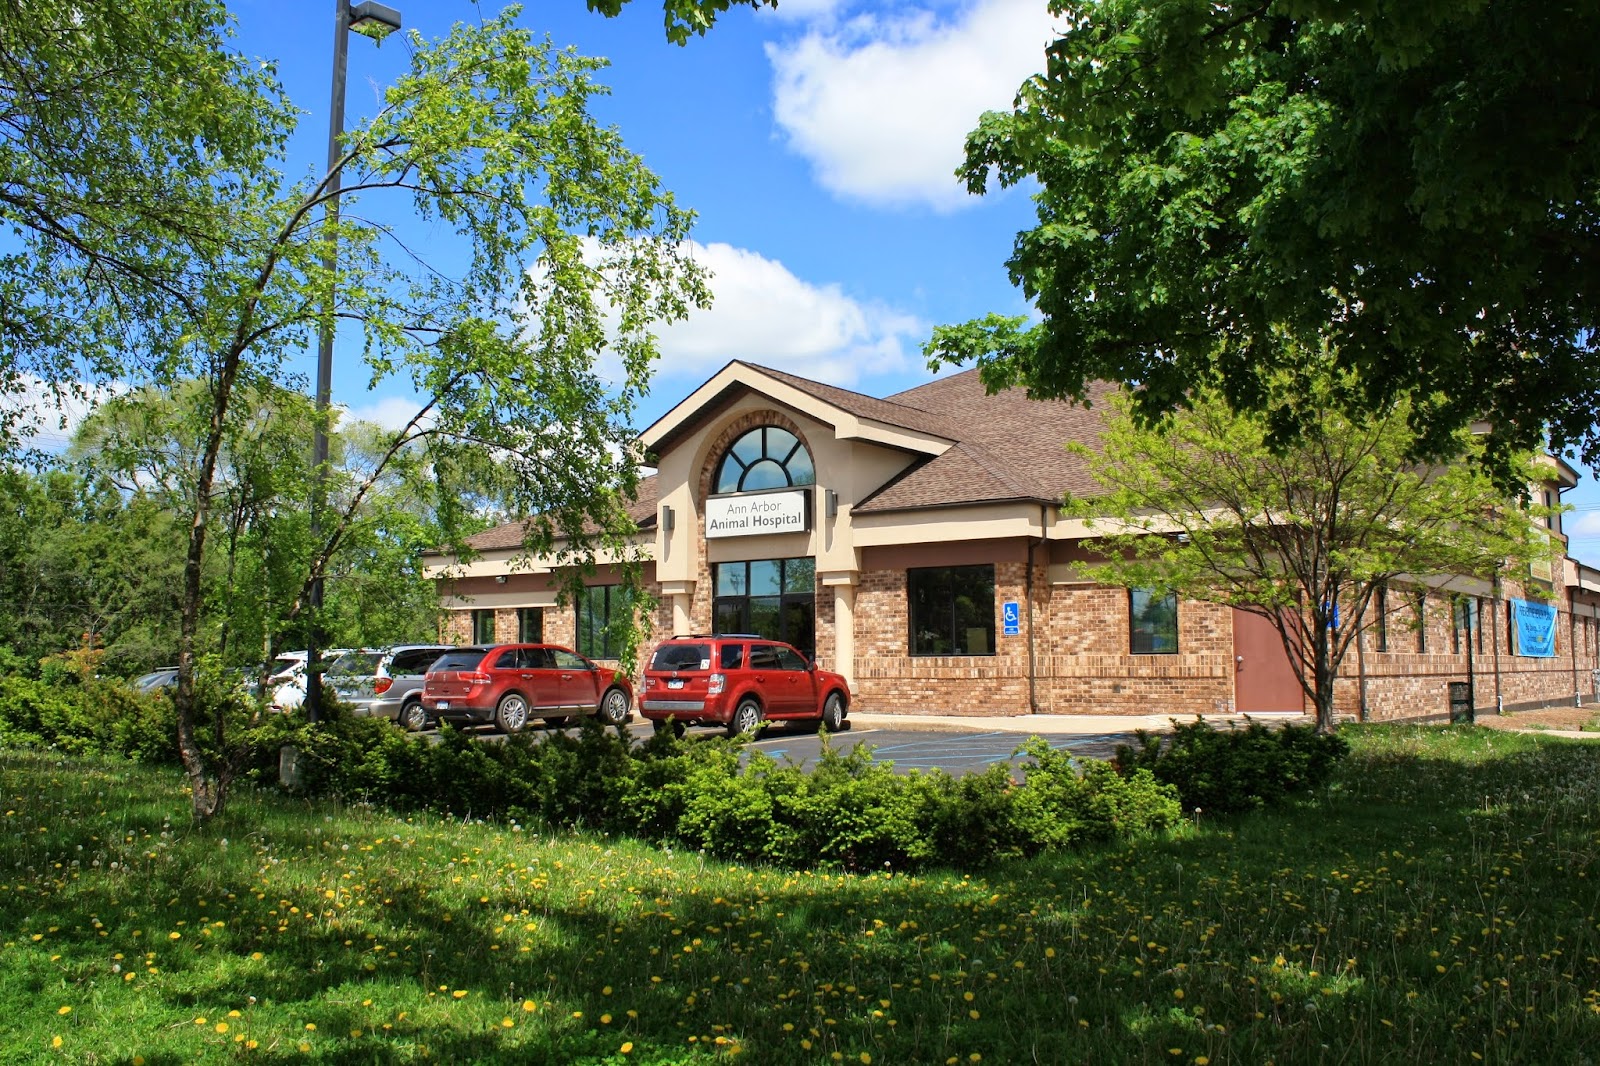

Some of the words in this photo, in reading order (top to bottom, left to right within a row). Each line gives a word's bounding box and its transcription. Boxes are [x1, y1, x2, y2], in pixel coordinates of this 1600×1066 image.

[727, 504, 747, 515] Ann
[750, 501, 782, 513] Arbor
[710, 516, 749, 530] Animal
[753, 512, 801, 528] Hospital
